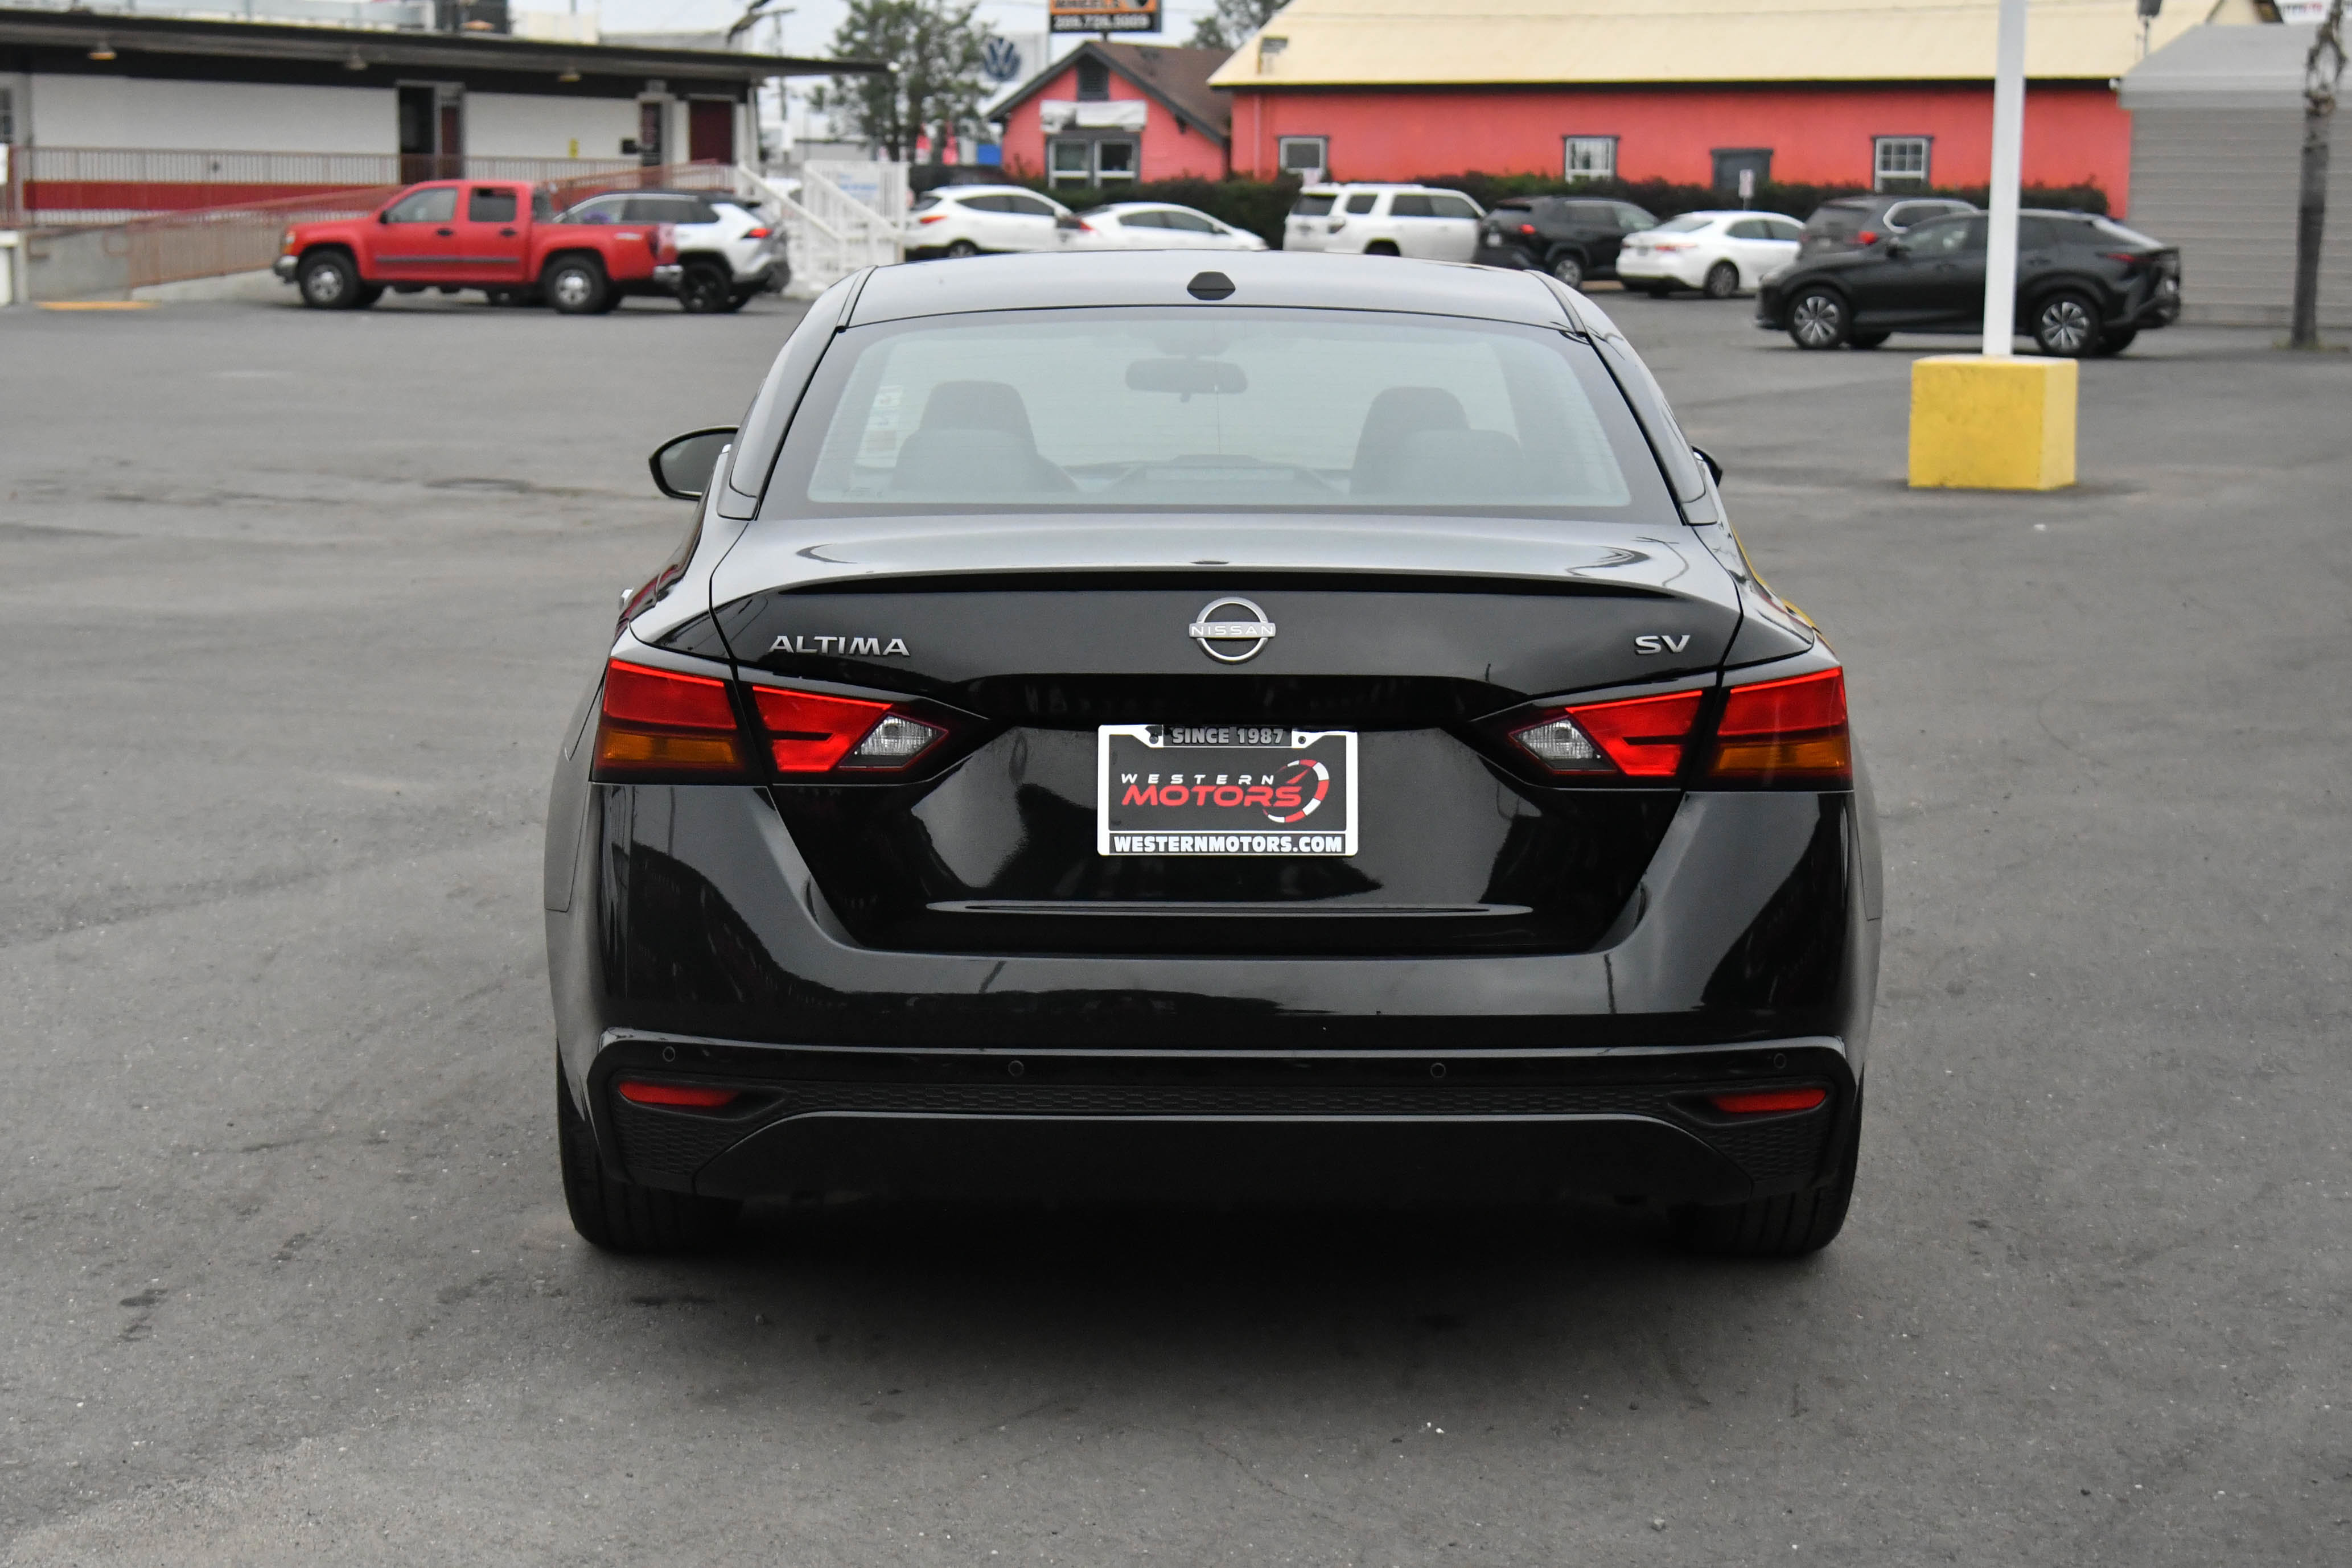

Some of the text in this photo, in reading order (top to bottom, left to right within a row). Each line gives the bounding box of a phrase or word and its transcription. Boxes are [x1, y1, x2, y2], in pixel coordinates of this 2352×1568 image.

[1191, 625, 1273, 636] NISSAN
[768, 635, 910, 656] ALTIMA
[1635, 635, 1691, 655] SV
[1171, 727, 1284, 745] SINCE 1987
[1121, 773, 1275, 785] WESTERN
[1121, 784, 1302, 808] MOTORS
[1113, 836, 1343, 853] WESTERNMOTORS.COM
